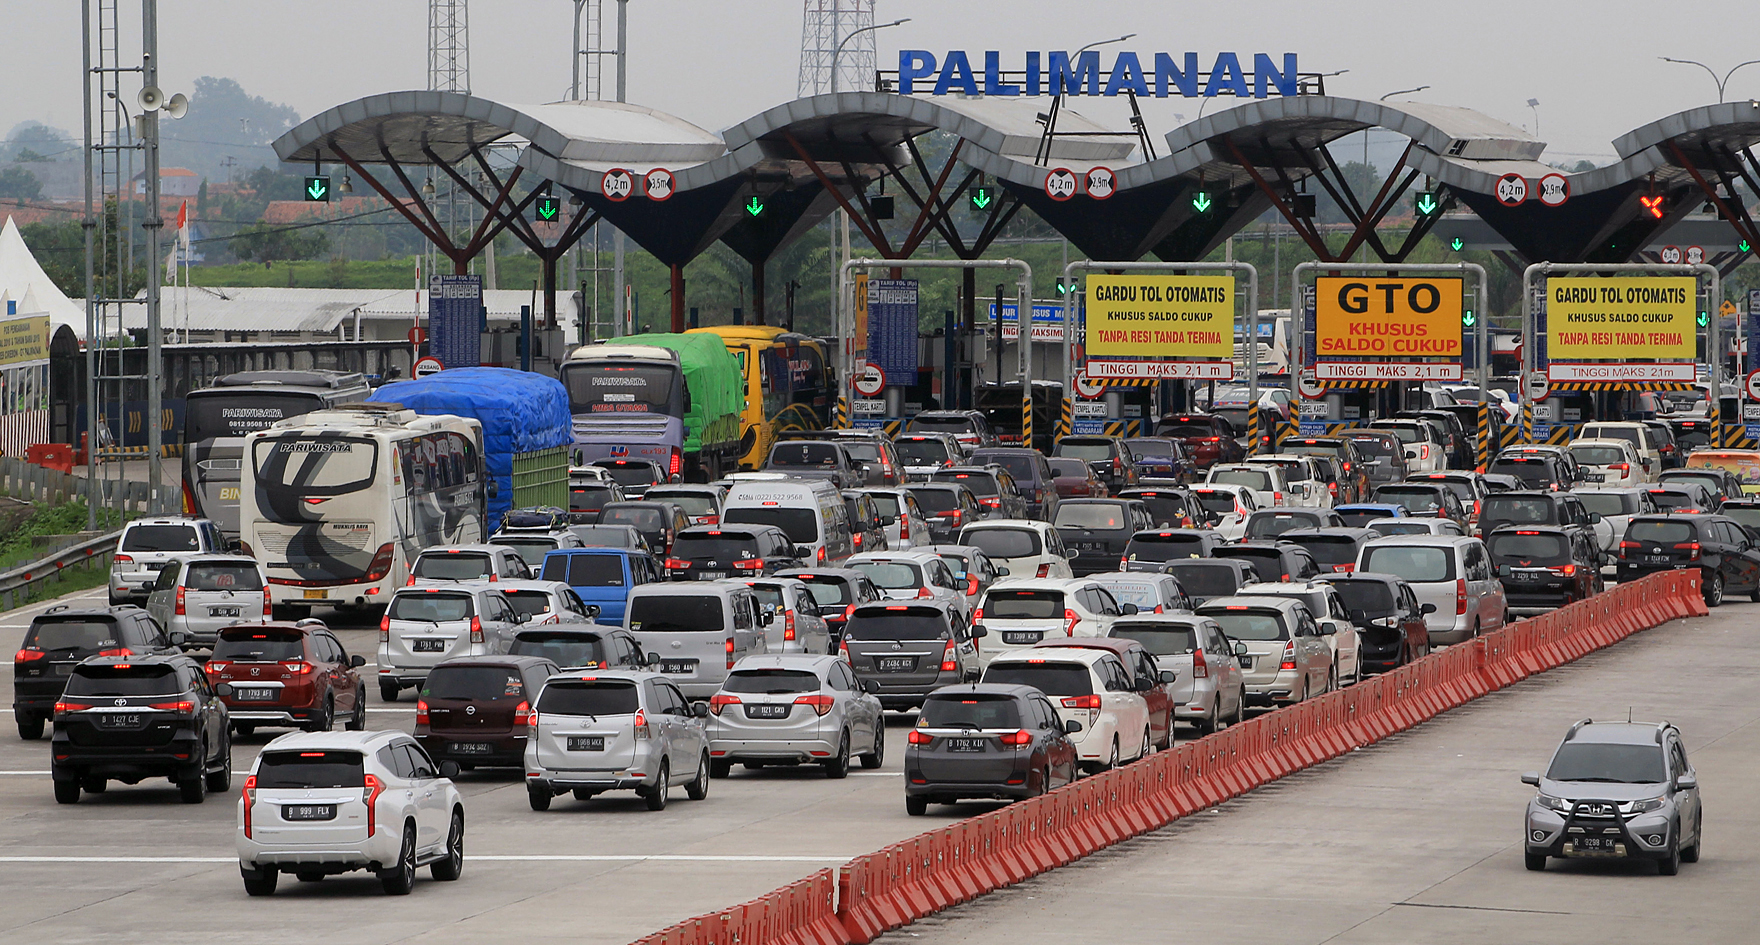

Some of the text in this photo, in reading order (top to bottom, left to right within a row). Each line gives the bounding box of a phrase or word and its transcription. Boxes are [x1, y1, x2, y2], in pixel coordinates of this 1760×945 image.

[898, 49, 1297, 98] PALIMANAN
[652, 178, 667, 190] 3,5m
[1092, 177, 1107, 189] 2,9m
[1545, 184, 1560, 196] 2,9m
[1096, 285, 1225, 303] GARDU TOL OTOMATIS
[1338, 282, 1441, 314] GTO
[1556, 287, 1686, 304] GARDU TOL OTOMATIS
[992, 308, 1016, 317] LJUR
[1108, 311, 1212, 322] KHUSUS SALDO CUKUP
[1568, 313, 1673, 323] KHUSUS SALDO CUKUP
[1031, 328, 1064, 337] MAKSIMU
[1349, 322, 1427, 337] KHUSUS
[1098, 330, 1221, 344] TANPA RESI TANDA TERIMA
[1558, 332, 1683, 346] TANPA RESI TANDA TERIMA
[1322, 338, 1457, 352] SALDO CUKUP
[1100, 364, 1220, 376] TINGGI MAKS 2,1 m
[1328, 366, 1449, 378] TINGGI MAKS 2,1 m
[1571, 368, 1608, 377] TINGGI
[1612, 368, 1645, 377] MAKS
[592, 377, 646, 386] PARIWISATA
[592, 404, 648, 412] HIBA UTAMA
[854, 403, 884, 411] TEMPEL KARTU
[1299, 405, 1313, 413] EMPEL
[222, 408, 283, 418] PARIWISATA
[280, 443, 352, 453] PARIWISATA
[300, 807, 311, 815] 999
[1575, 838, 1579, 846] R
[1606, 839, 1614, 847] GK
